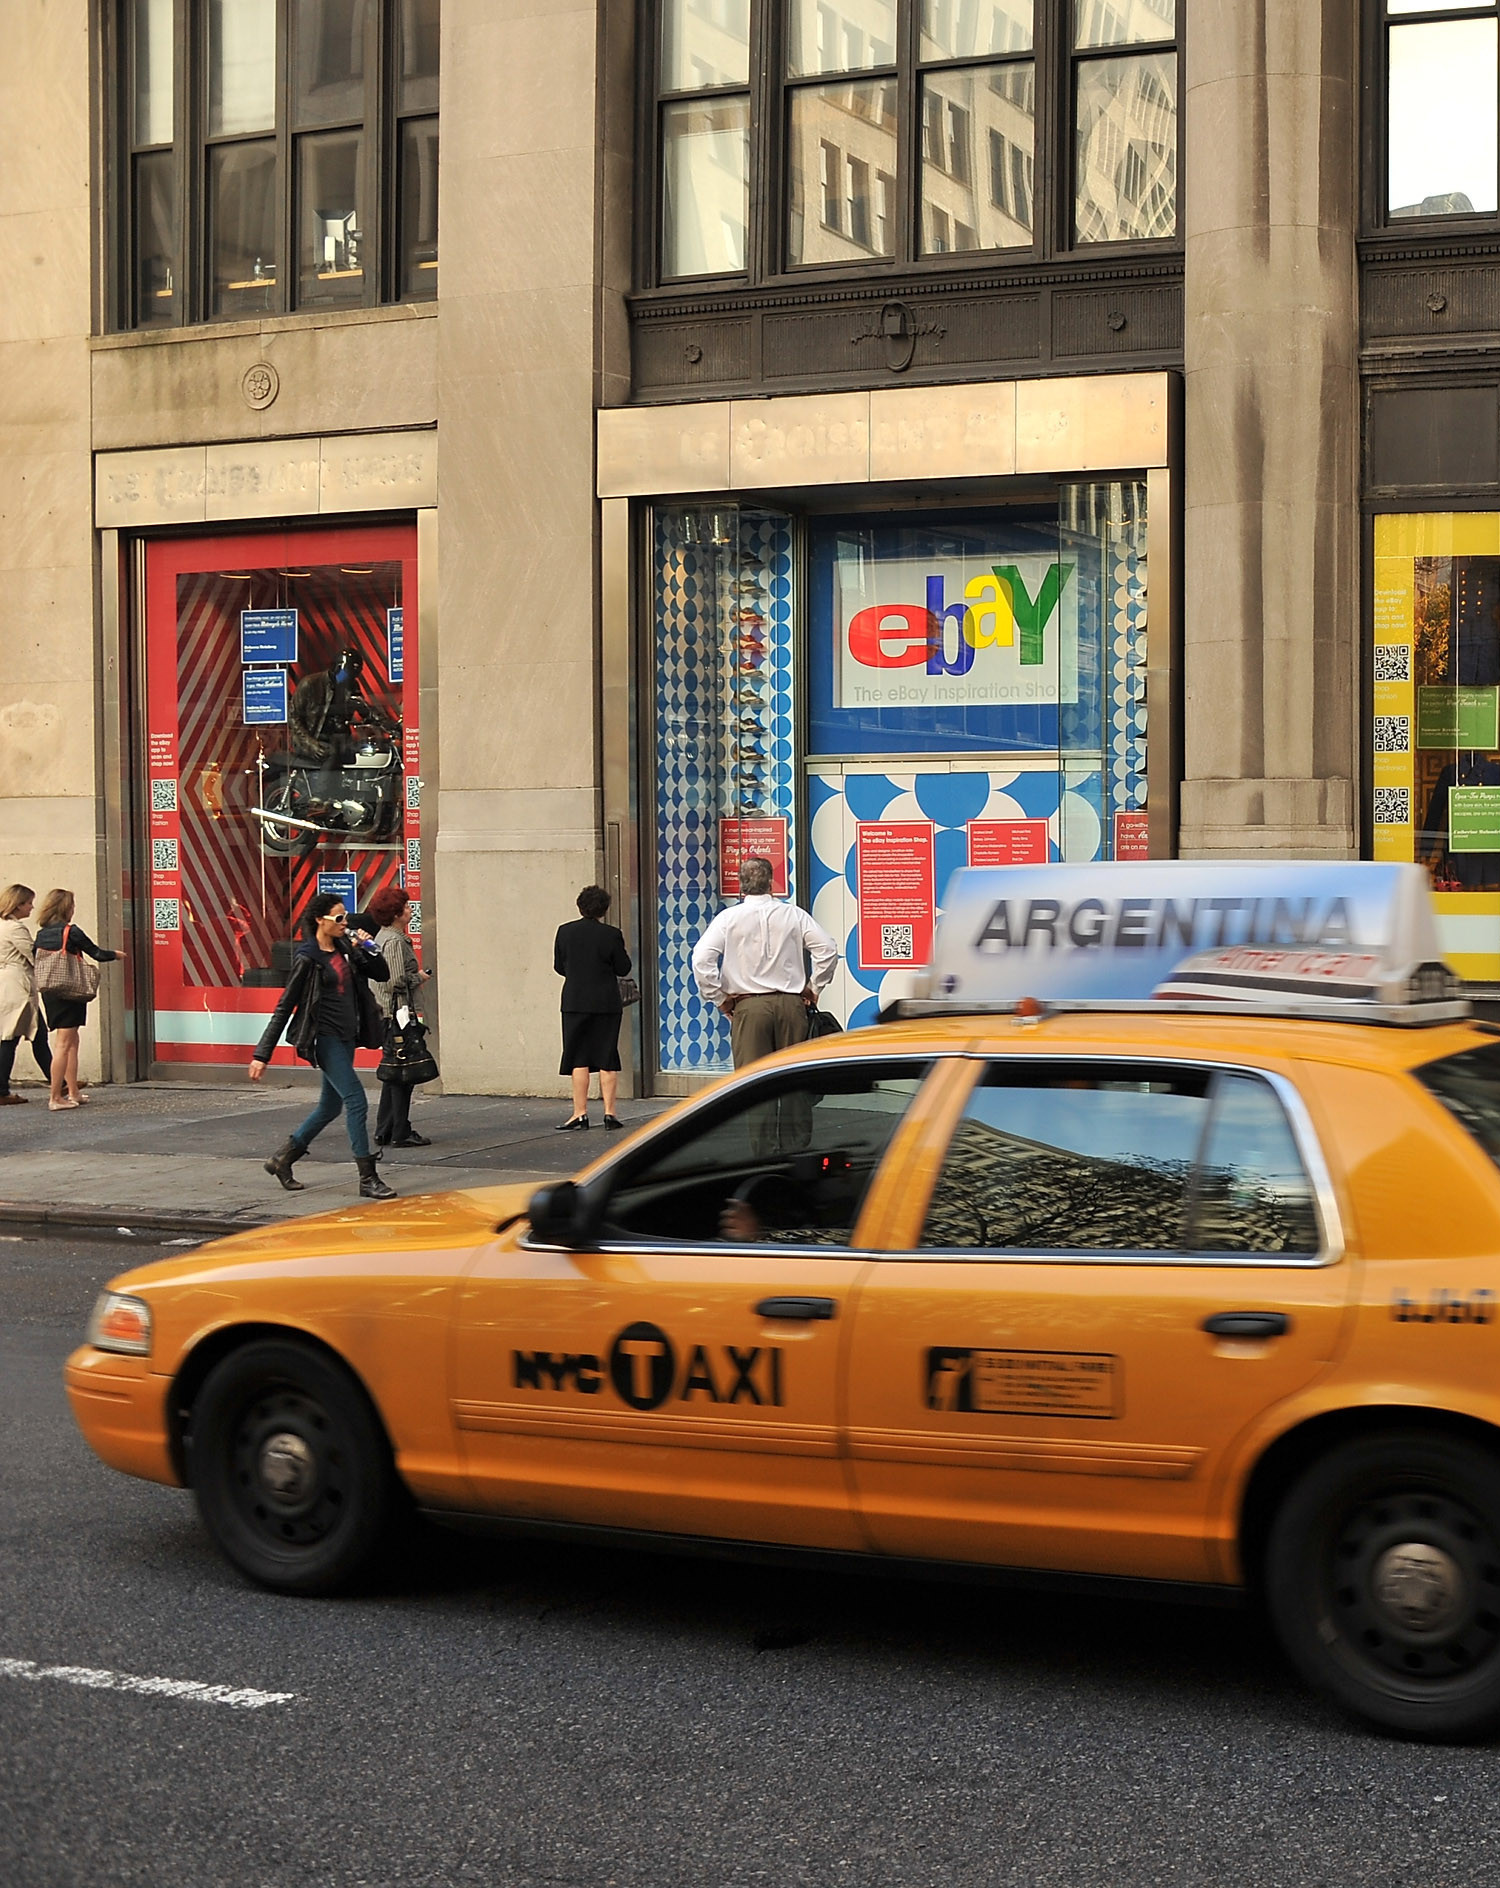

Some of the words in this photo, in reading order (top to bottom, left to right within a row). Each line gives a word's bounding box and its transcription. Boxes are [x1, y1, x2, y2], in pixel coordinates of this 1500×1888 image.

[853, 686, 883, 702] The
[887, 685, 929, 704] eBay
[934, 682, 1023, 703] Inspiration
[976, 898, 1356, 948] ARGENTINA
[511, 1349, 605, 1395] NYC
[617, 1340, 786, 1407] TAXI
